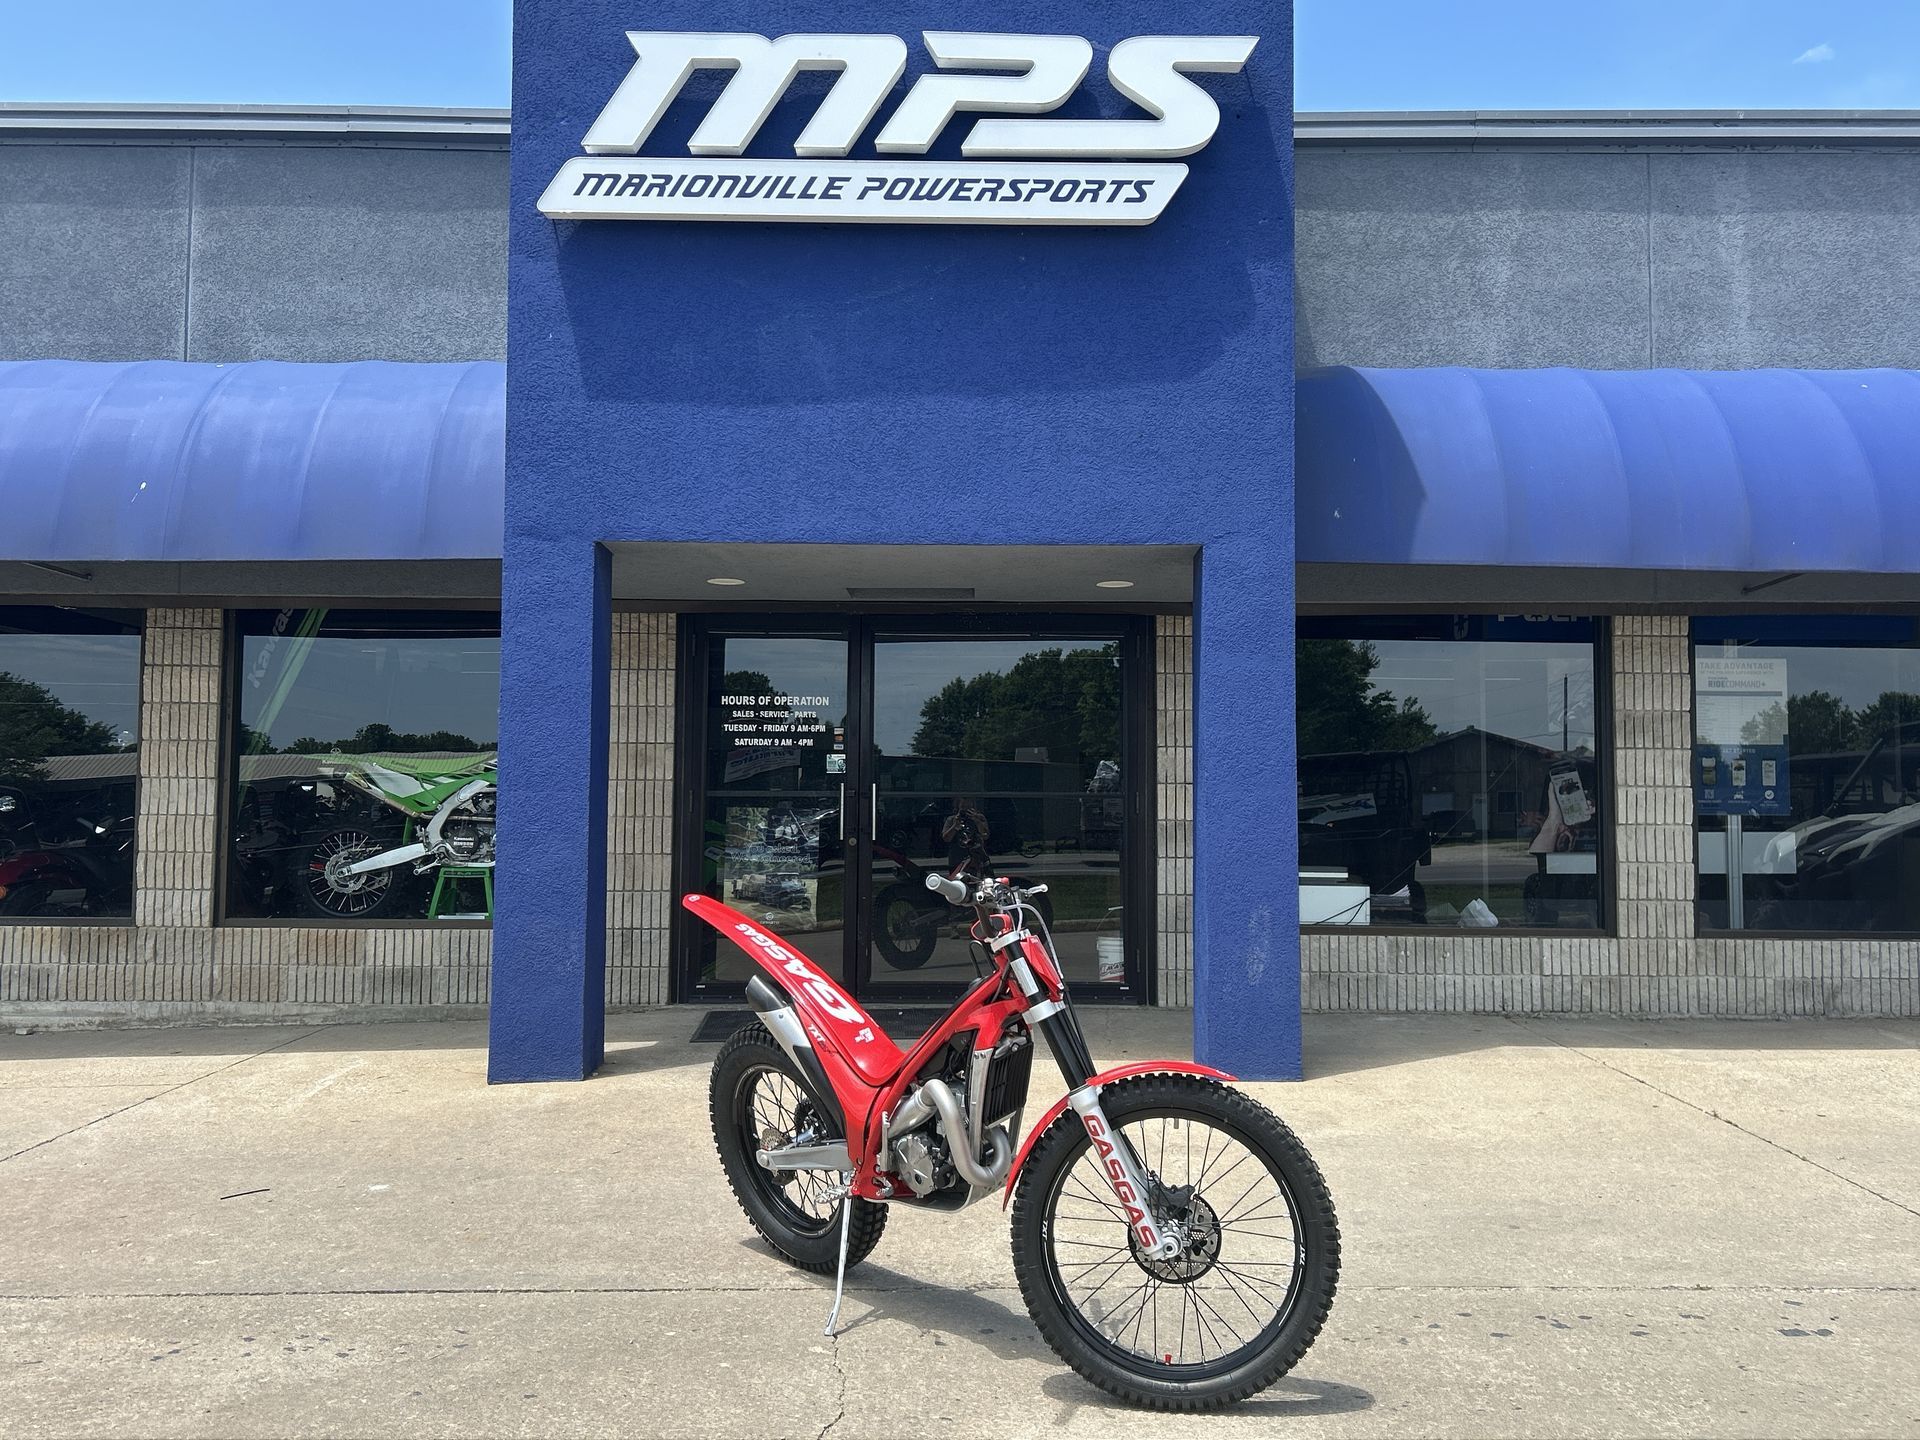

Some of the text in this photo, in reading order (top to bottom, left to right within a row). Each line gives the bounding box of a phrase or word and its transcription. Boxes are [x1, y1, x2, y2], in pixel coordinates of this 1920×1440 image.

[581, 31, 1260, 157] MPS
[576, 172, 1156, 204] MARIONVILLE POWERSPORTS
[1700, 662, 1774, 670] TAKE ADVANTAGE
[721, 695, 829, 706] HOURS OF OPERATION
[732, 710, 754, 718] SALES
[723, 724, 757, 732] TUESDAY
[763, 724, 789, 732] FRIDAY
[734, 738, 773, 746] SATURDAY
[735, 923, 865, 1023] GASGAS
[808, 1024, 826, 1042] TXT
[1083, 1114, 1157, 1247] GASGAS
